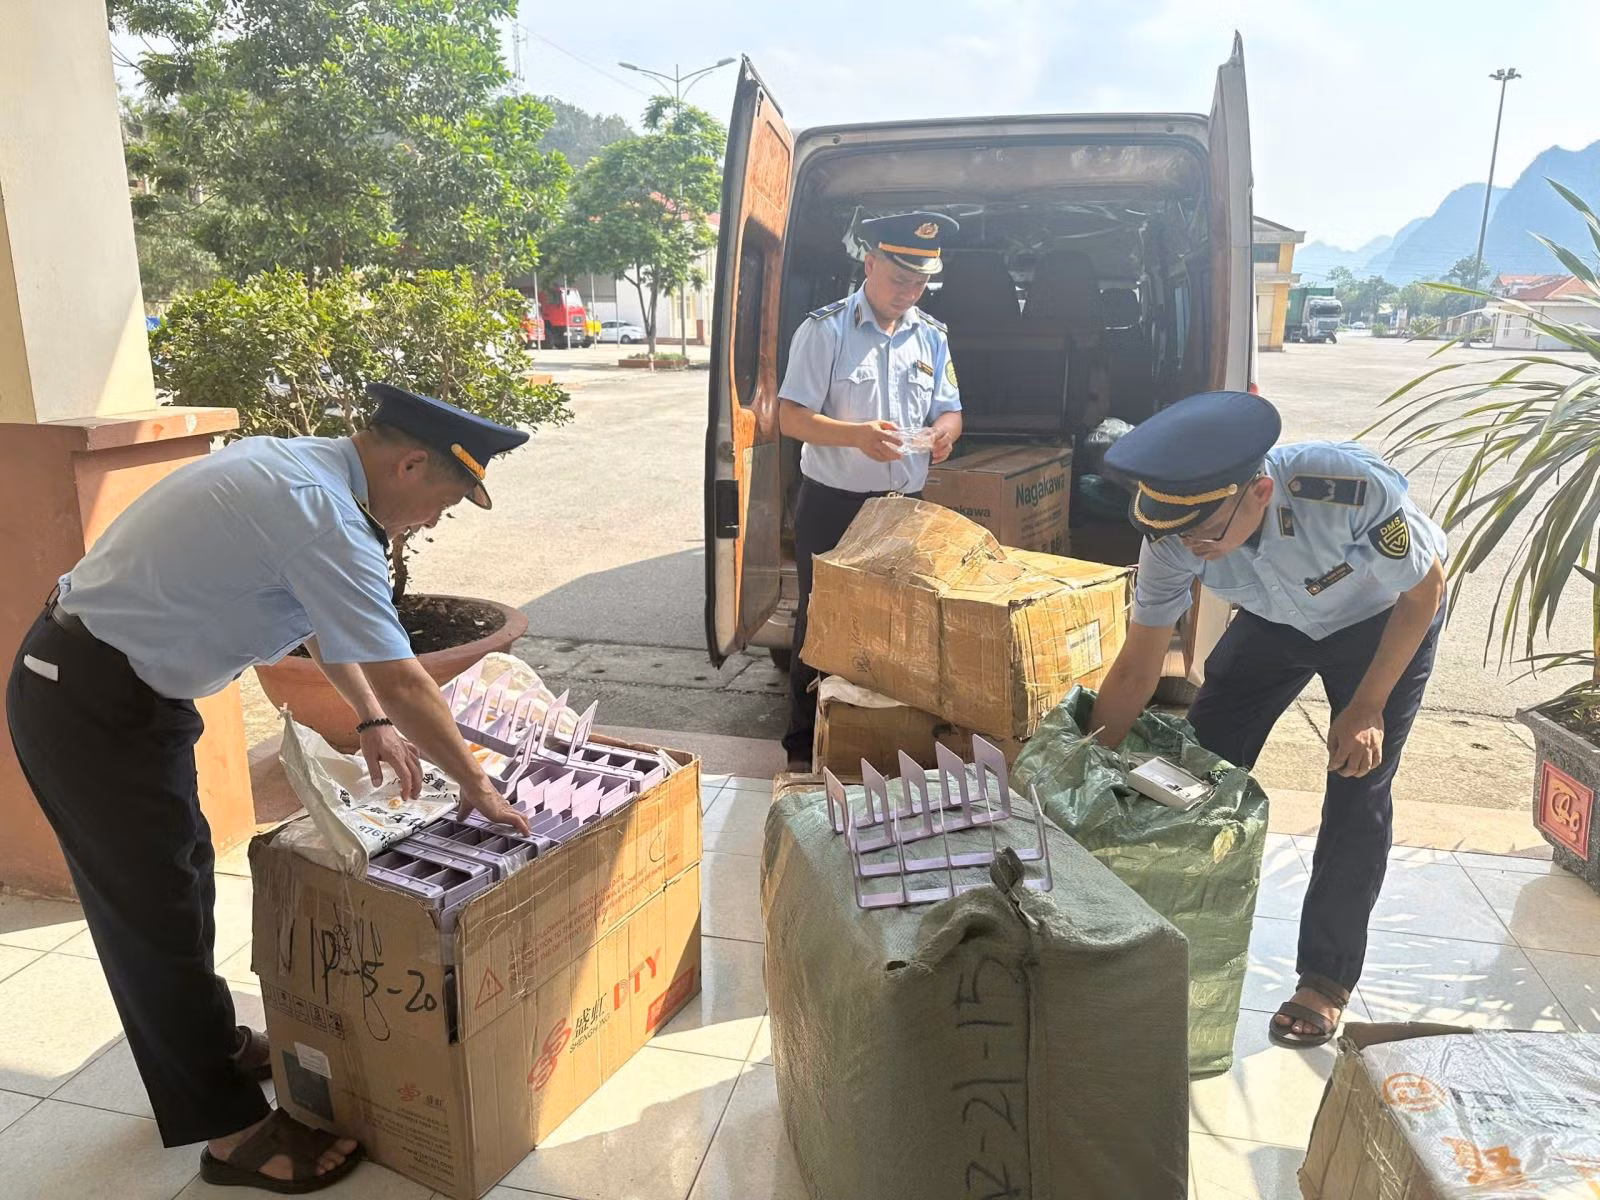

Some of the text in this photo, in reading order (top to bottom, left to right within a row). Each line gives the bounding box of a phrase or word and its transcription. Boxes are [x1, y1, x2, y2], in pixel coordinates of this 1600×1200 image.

[1015, 473, 1065, 508] Nagakawa
[952, 505, 991, 517] akawa
[1380, 516, 1401, 536] DMS
[613, 948, 661, 1011] DTY
[575, 992, 607, 1038] 盛虹
